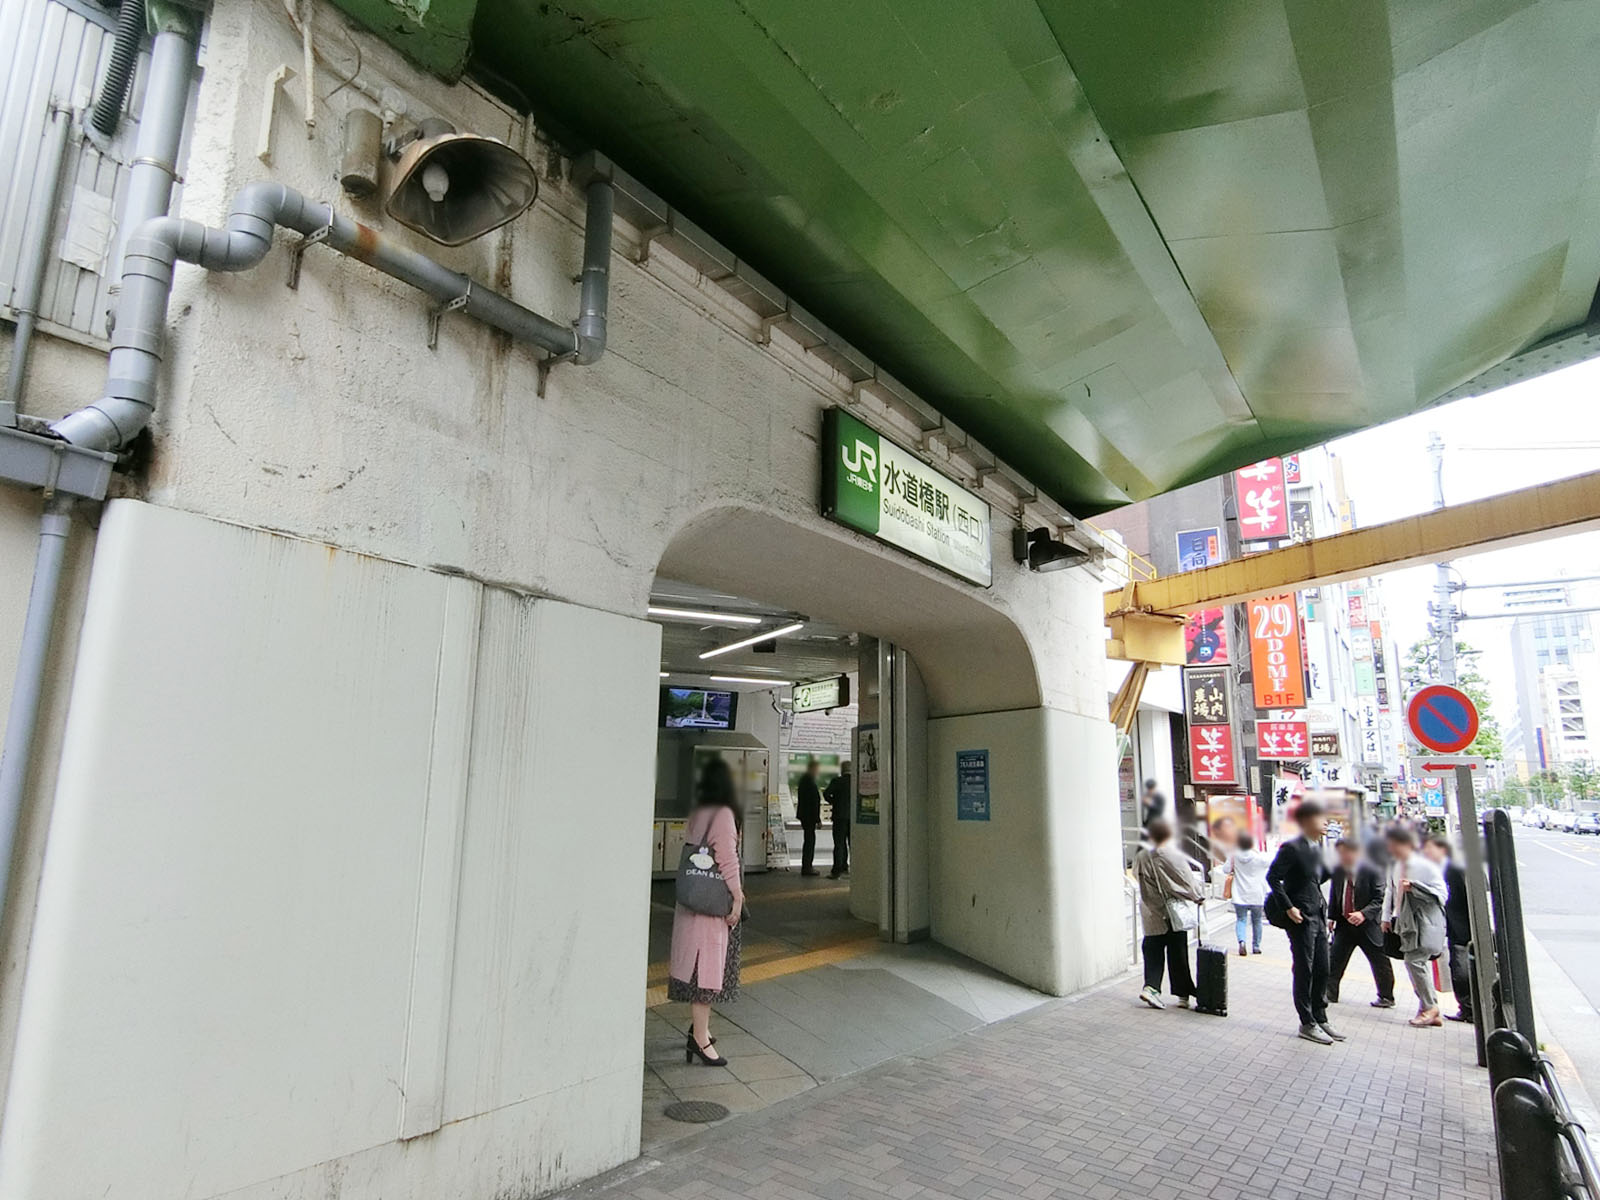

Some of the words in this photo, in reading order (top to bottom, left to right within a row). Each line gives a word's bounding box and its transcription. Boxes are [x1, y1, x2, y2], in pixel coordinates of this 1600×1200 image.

[842, 439, 877, 483] JR
[846, 476, 873, 492] JR東日本
[883, 460, 949, 524] 水道橋駅
[952, 503, 984, 545] (西口)
[926, 521, 950, 545] Station
[1253, 604, 1294, 639] 29
[1267, 638, 1289, 692] DOME
[1264, 693, 1295, 705] B1F
[686, 869, 708, 877] DEAN
